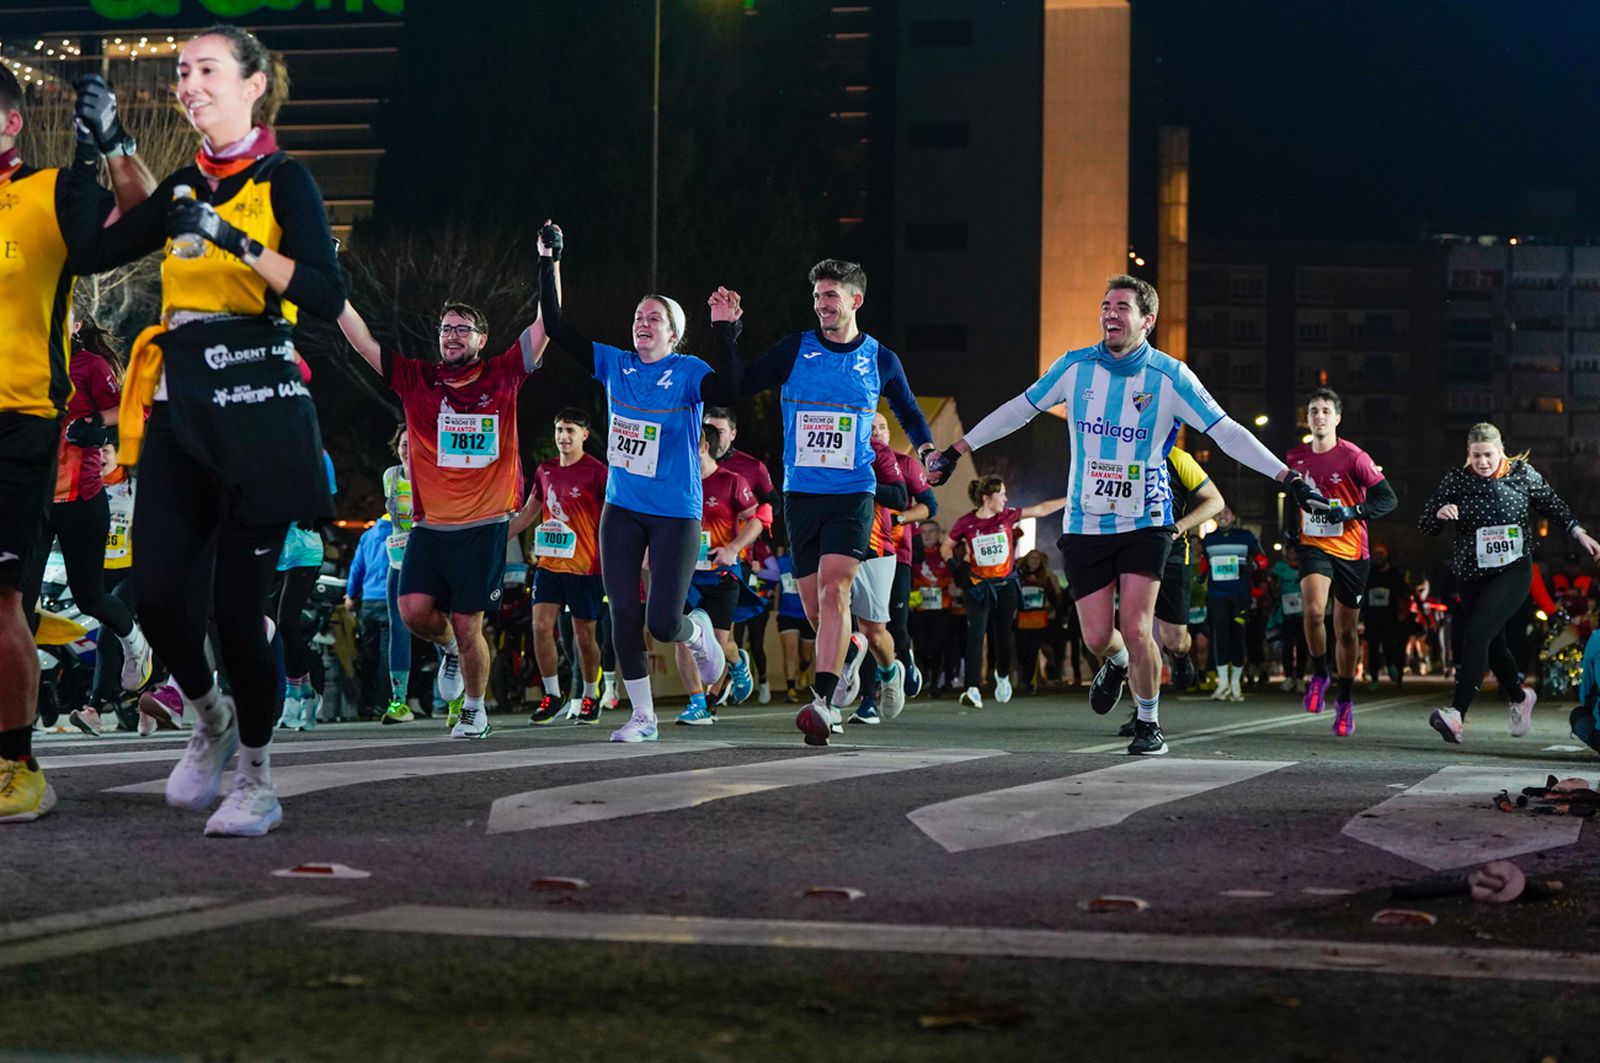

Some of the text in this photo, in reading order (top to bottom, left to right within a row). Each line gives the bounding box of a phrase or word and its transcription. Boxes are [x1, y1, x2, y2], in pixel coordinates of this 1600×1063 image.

[451, 433, 486, 450] 7812
[617, 435, 647, 456] 2477
[807, 431, 843, 450] 2479
[1094, 479, 1133, 499] 2478
[544, 532, 568, 545] 7007
[981, 544, 1003, 556] 6832
[1486, 540, 1515, 555] 6991
